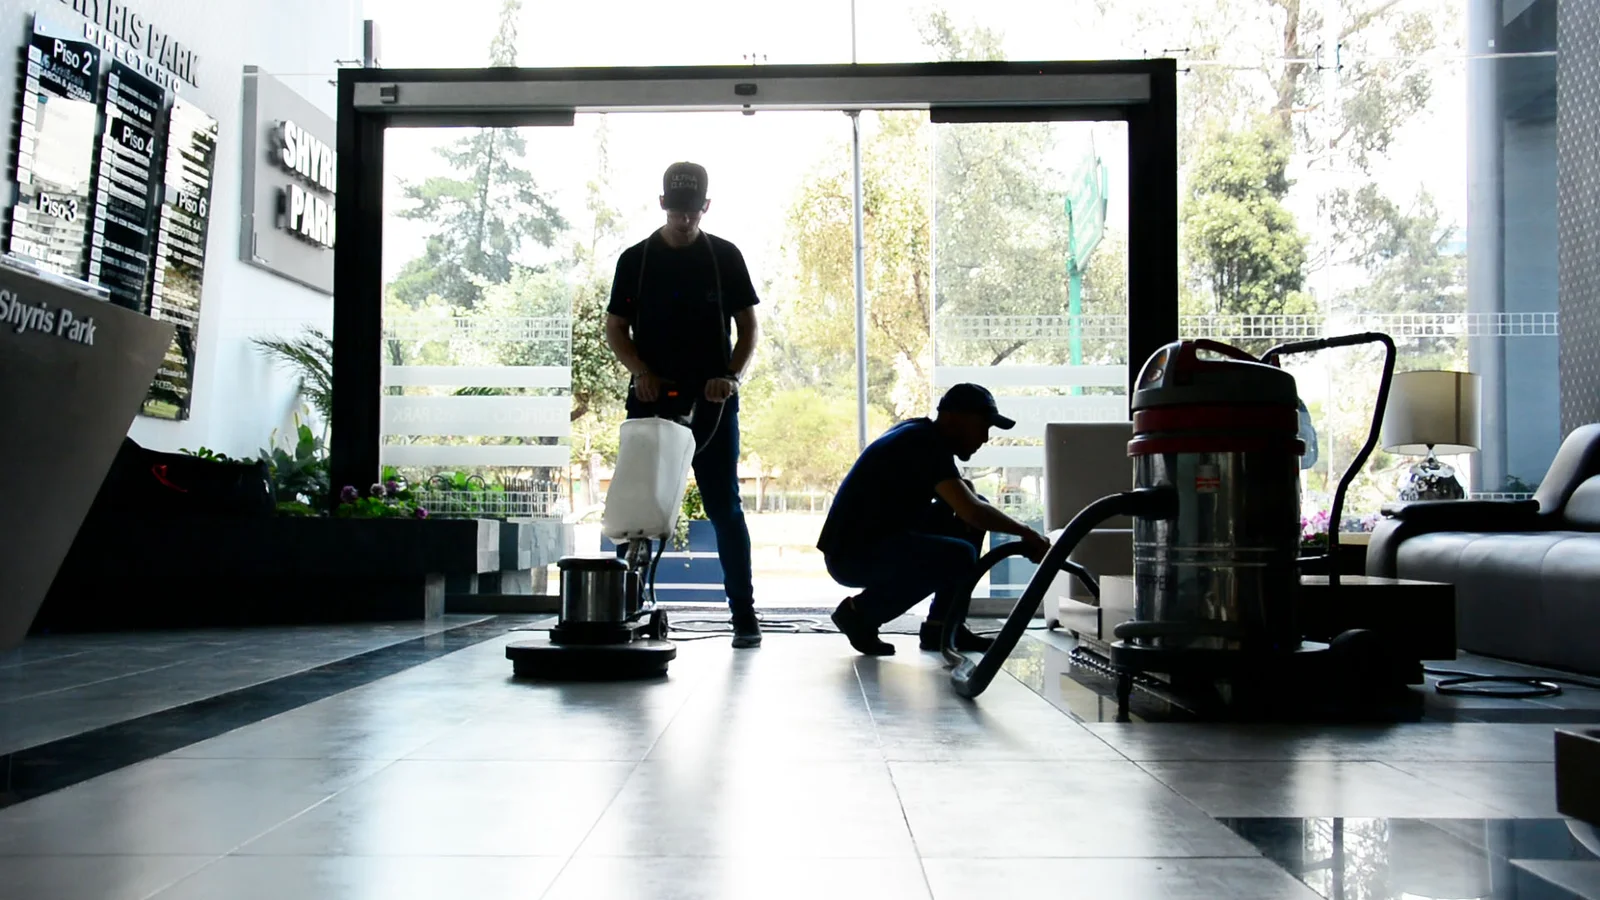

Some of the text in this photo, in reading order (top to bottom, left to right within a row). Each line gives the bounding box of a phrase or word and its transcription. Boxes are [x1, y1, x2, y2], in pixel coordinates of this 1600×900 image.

[54, 38, 80, 69] Piso
[82, 50, 94, 76] 2
[60, 0, 145, 50] YRIS
[147, 23, 201, 88] PARK
[84, 22, 182, 94] DIRECTORIO
[122, 125, 144, 151] Piso
[145, 137, 155, 158] 4
[40, 192, 78, 222] Piso 3
[178, 190, 198, 214] Piso
[198, 197, 208, 218] 6
[0, 289, 97, 346] Shyris Park
